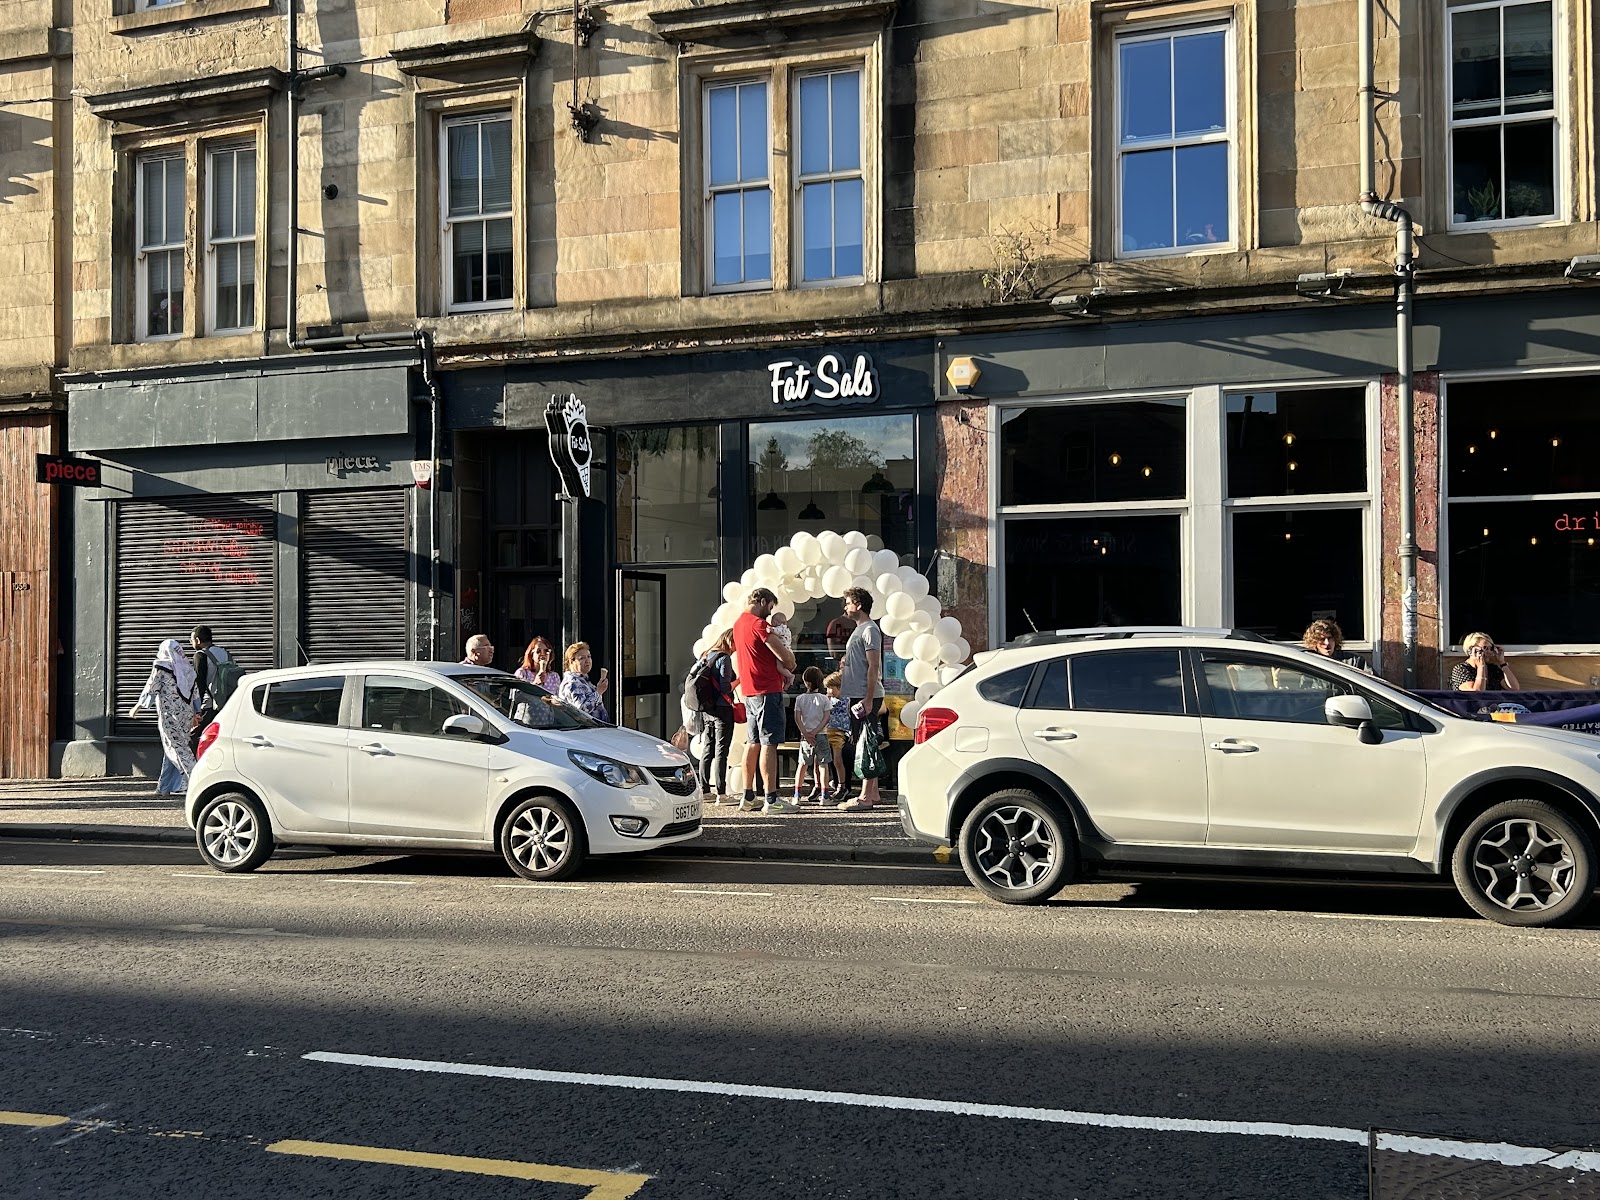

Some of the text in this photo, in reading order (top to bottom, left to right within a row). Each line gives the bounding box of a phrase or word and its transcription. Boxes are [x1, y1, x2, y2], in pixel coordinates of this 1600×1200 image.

[768, 354, 873, 403] Fat Sals
[571, 435, 579, 449] Fat
[45, 459, 96, 481] piece
[325, 451, 378, 474] piece
